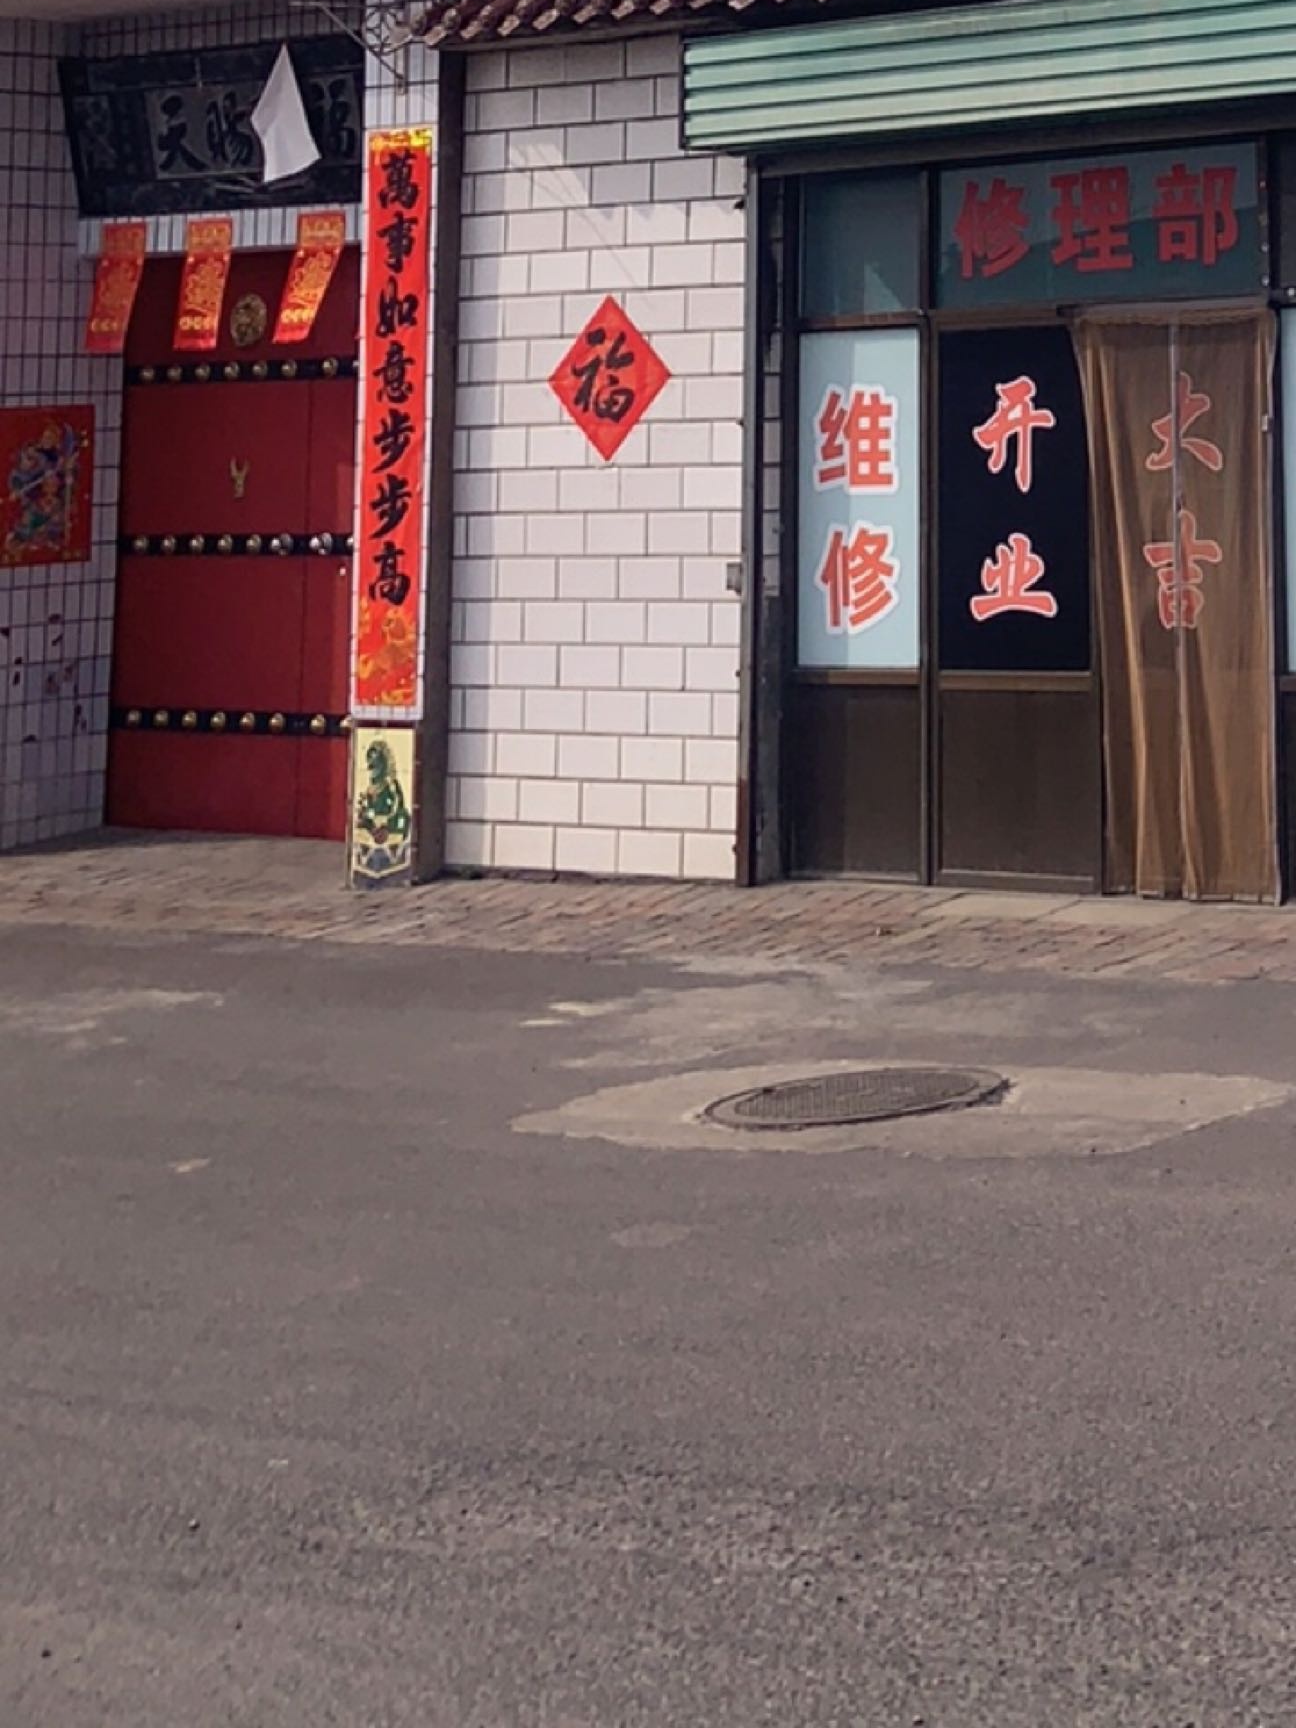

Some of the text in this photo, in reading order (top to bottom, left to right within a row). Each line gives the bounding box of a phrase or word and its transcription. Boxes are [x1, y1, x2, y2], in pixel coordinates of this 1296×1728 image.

[953, 164, 1241, 278] 修理部
[571, 330, 633, 424] 福
[814, 383, 898, 633] 维修
[969, 376, 1057, 621] 开业
